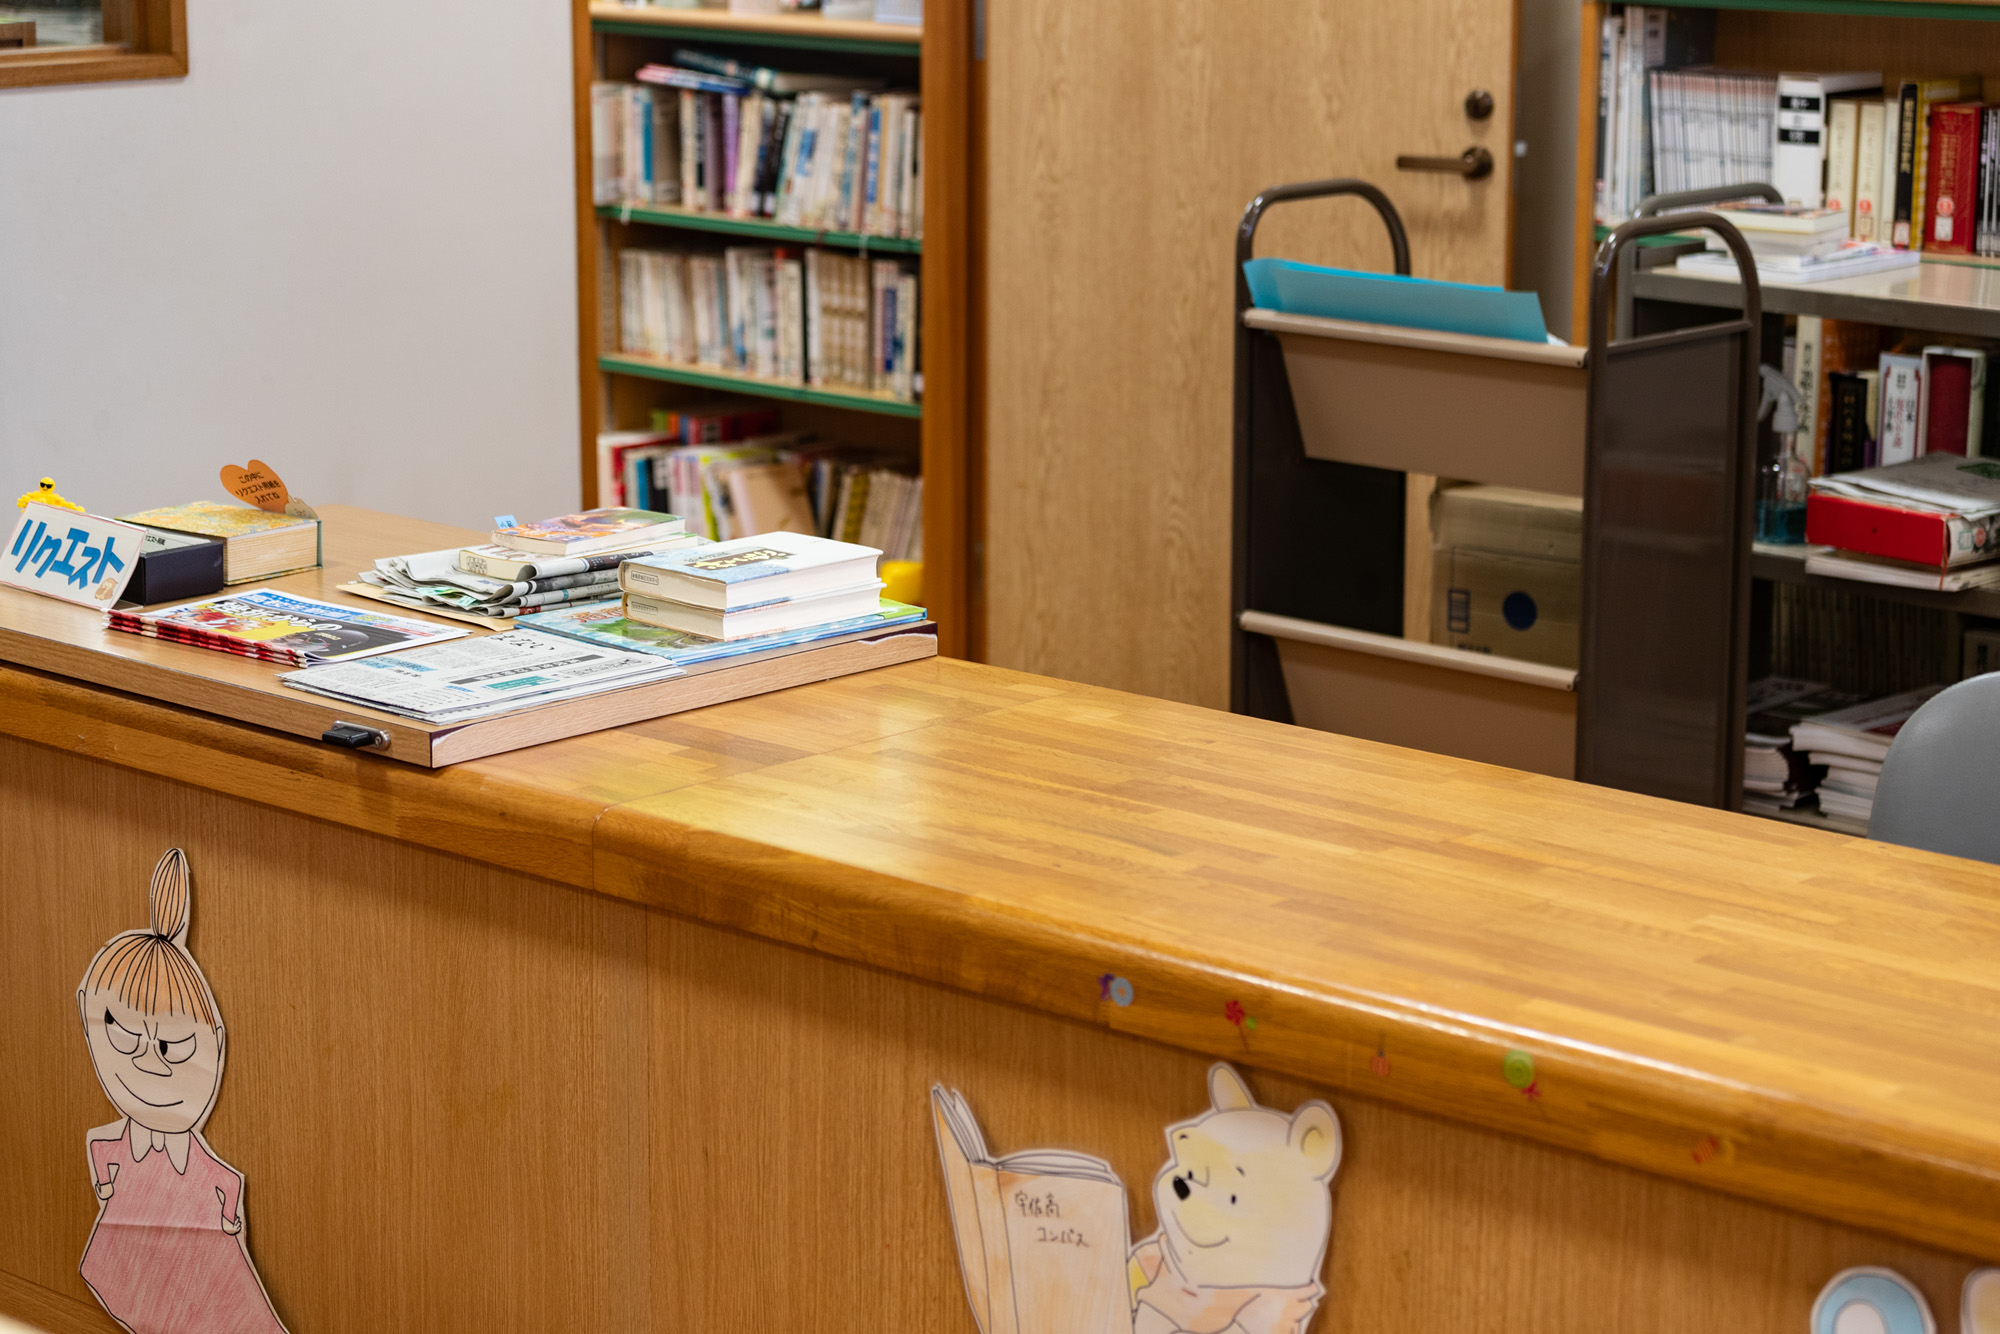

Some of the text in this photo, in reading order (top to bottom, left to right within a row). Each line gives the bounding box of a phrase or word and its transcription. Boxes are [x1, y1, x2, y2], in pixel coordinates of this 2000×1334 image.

[238, 472, 264, 484] この中に
[235, 480, 281, 497] リクエスト用紙を
[254, 492, 280, 504] 入れてね
[11, 518, 125, 590] リクエスト
[1015, 1189, 1060, 1218] 宇佐高
[1037, 1226, 1089, 1248] コンパス
